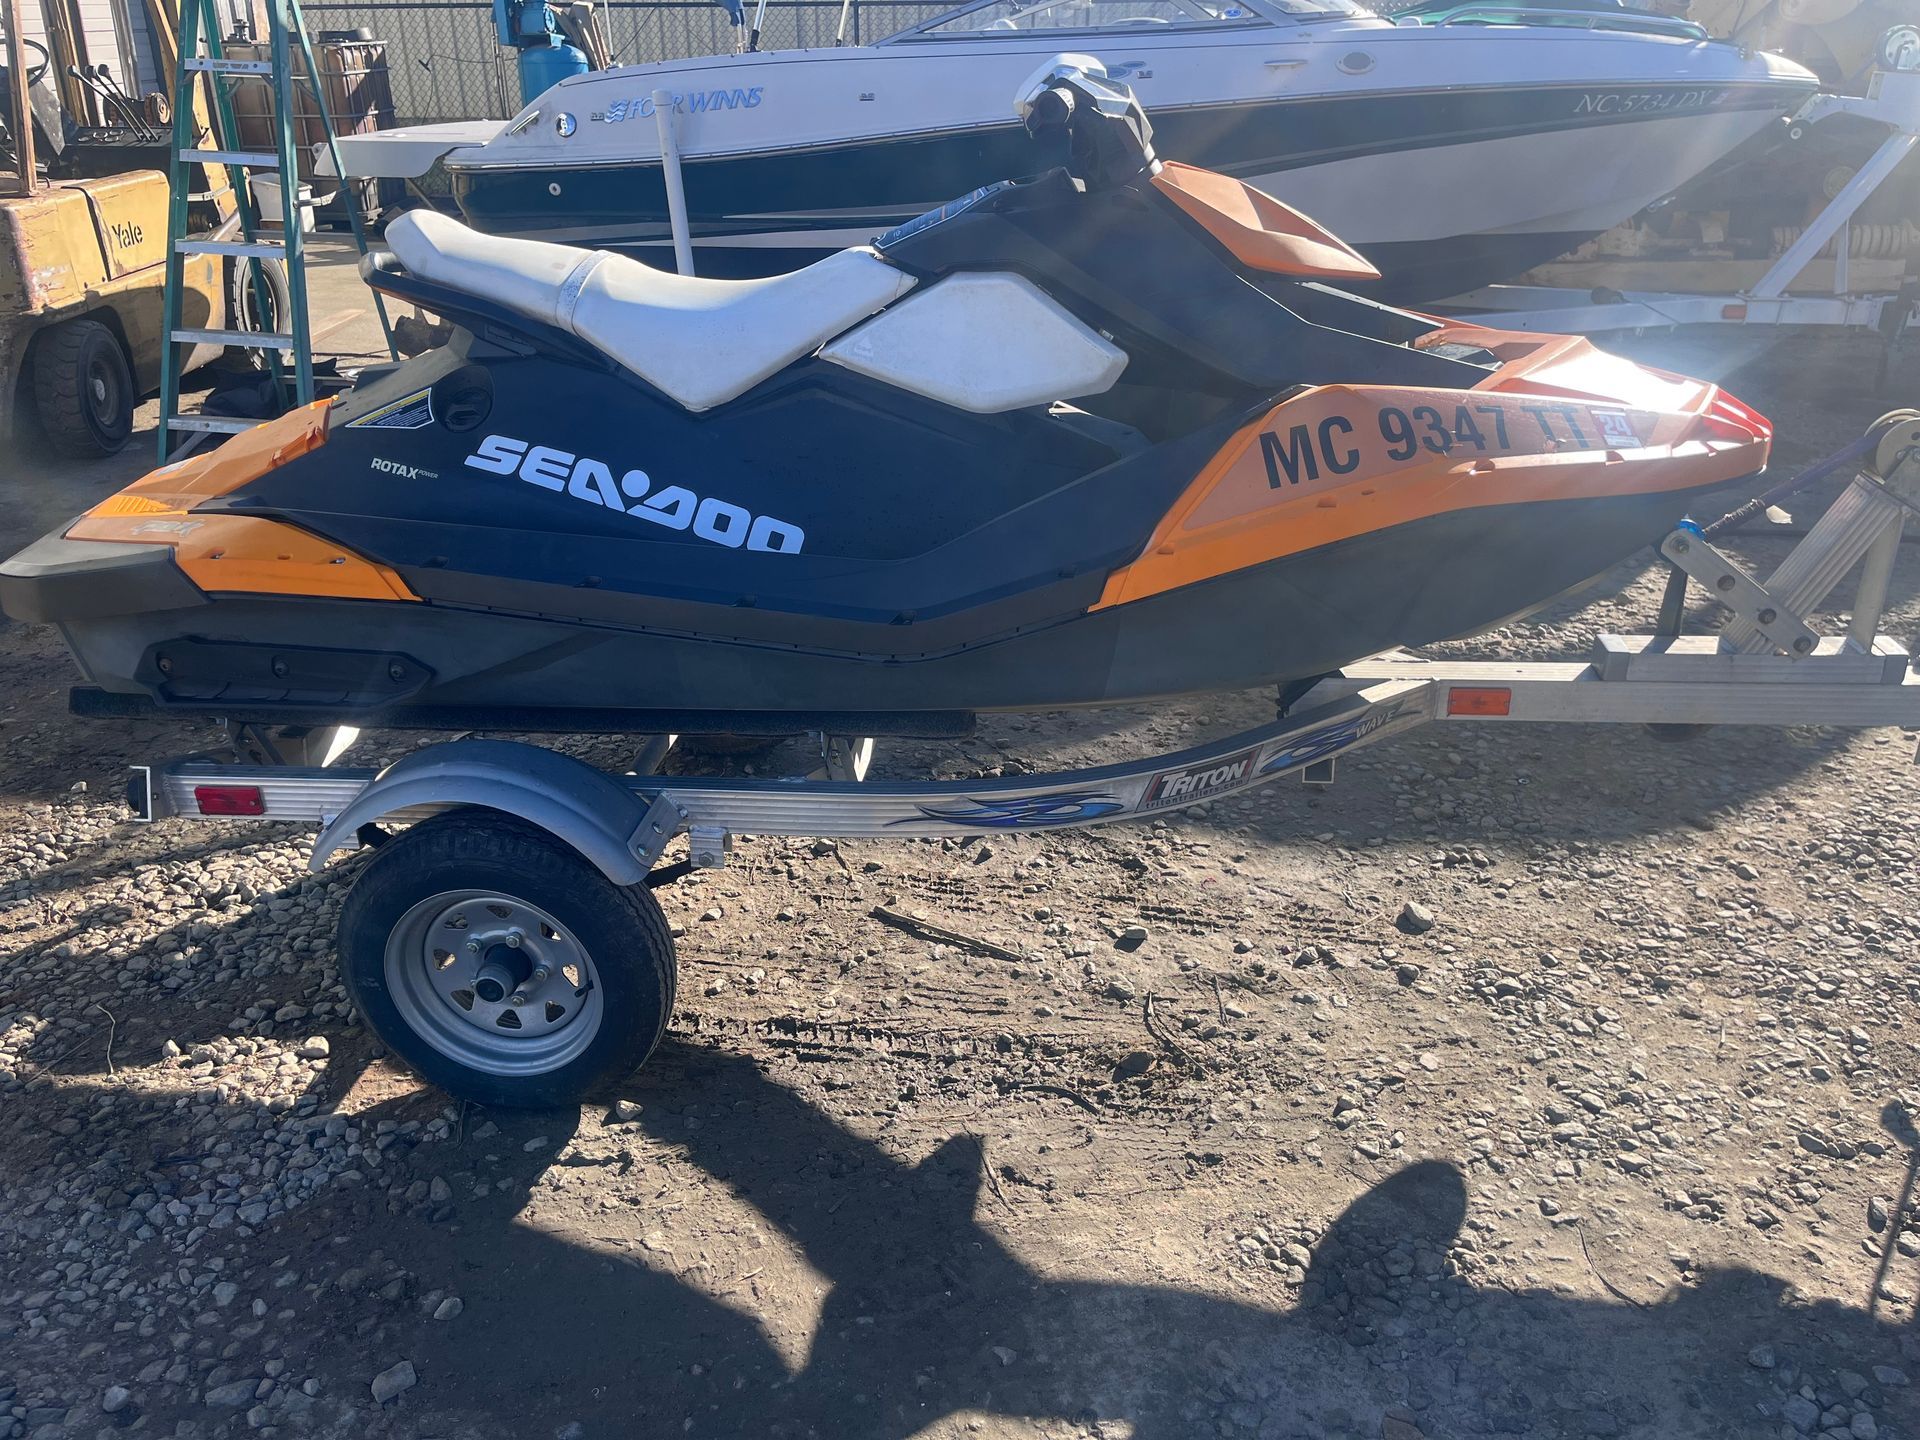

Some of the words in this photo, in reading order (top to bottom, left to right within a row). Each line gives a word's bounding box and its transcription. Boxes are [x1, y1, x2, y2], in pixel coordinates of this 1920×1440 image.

[627, 95, 685, 120] FOR
[687, 86, 764, 114] WINNS
[1573, 94, 1619, 113] NC
[111, 221, 143, 249] Yale
[1600, 415, 1633, 436] 24
[1259, 415, 1361, 490] MC
[1377, 405, 1512, 462] 9347
[1520, 405, 1592, 449] TT
[370, 457, 419, 480] ROTAX
[417, 468, 439, 480] POWER
[1355, 709, 1396, 739] WAVE
[1145, 779, 1244, 809] tritontrailers.com
[1160, 759, 1249, 799] TRITON
